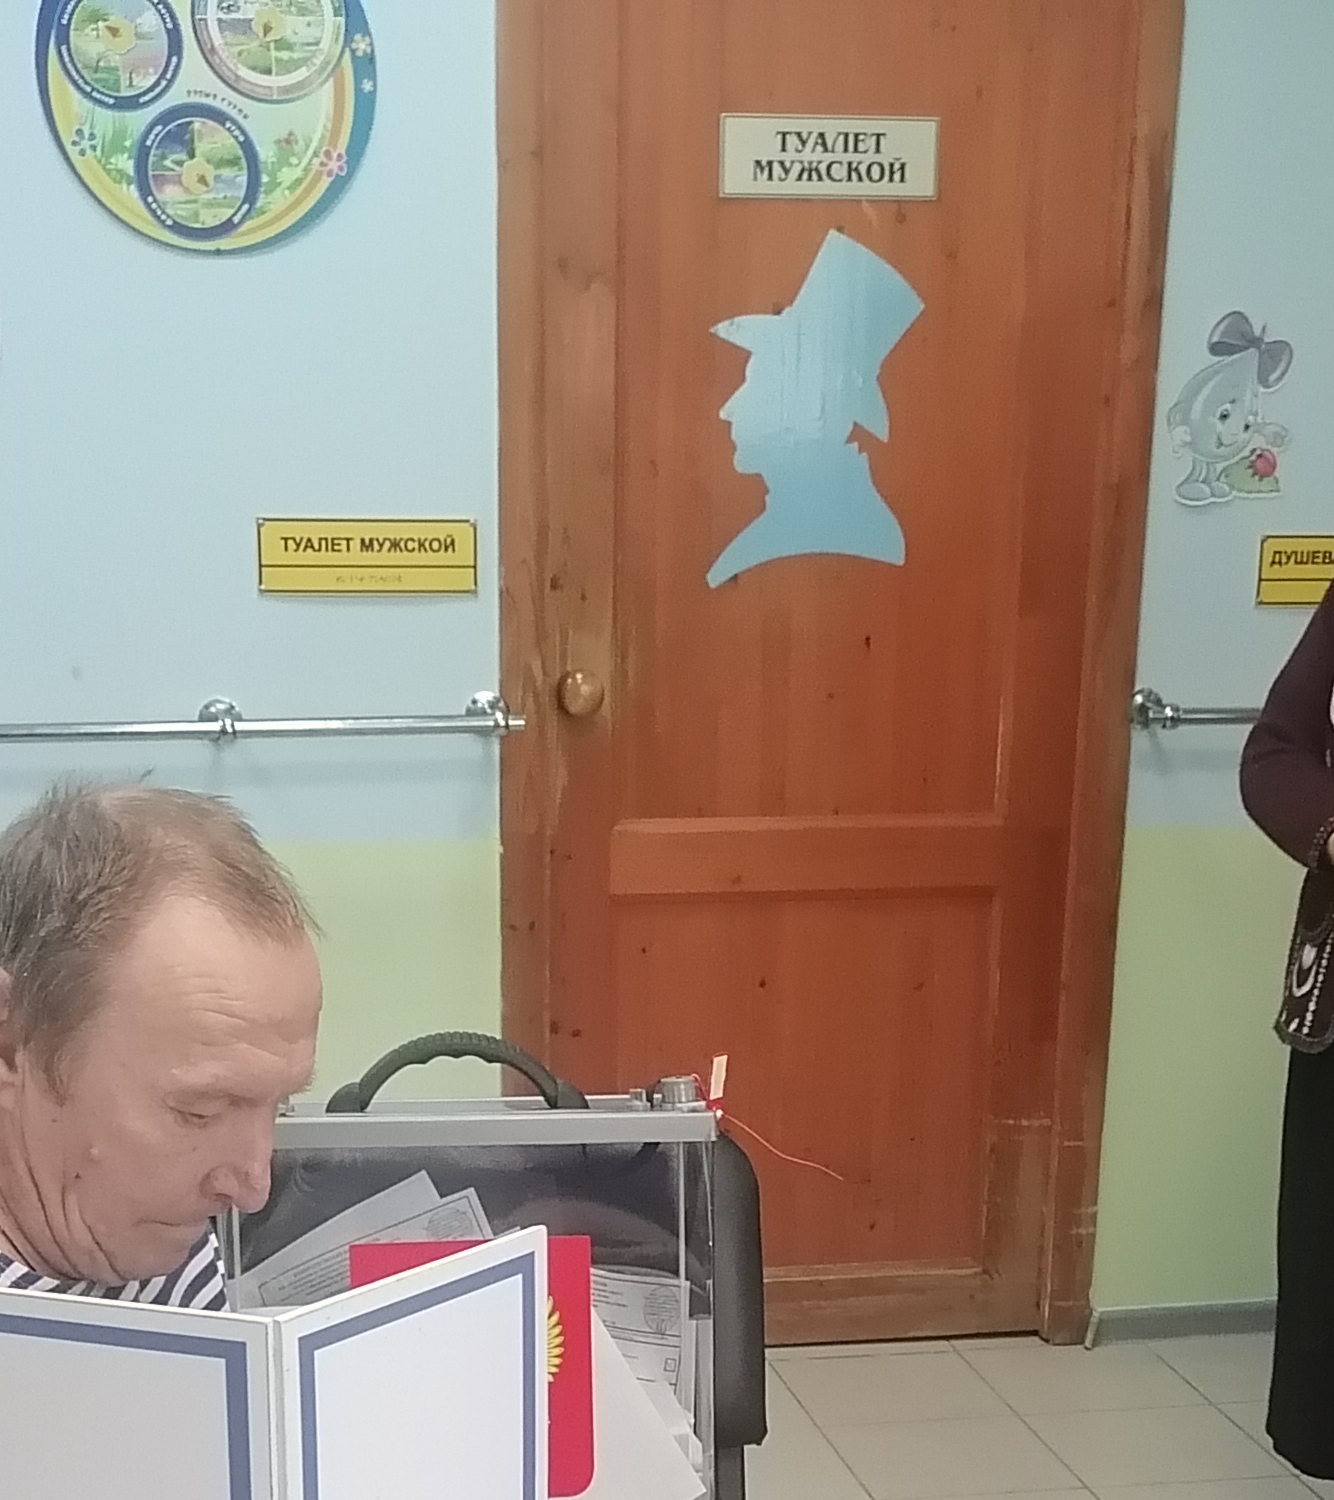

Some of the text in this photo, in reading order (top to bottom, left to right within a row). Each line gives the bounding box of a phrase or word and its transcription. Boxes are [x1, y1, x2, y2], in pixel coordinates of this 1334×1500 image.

[775, 131, 887, 154] ТУАЛЕТ
[752, 158, 907, 183] МУЖСКОЙ
[281, 534, 456, 554] ТУАЛЕТ МУЖСКОЙ
